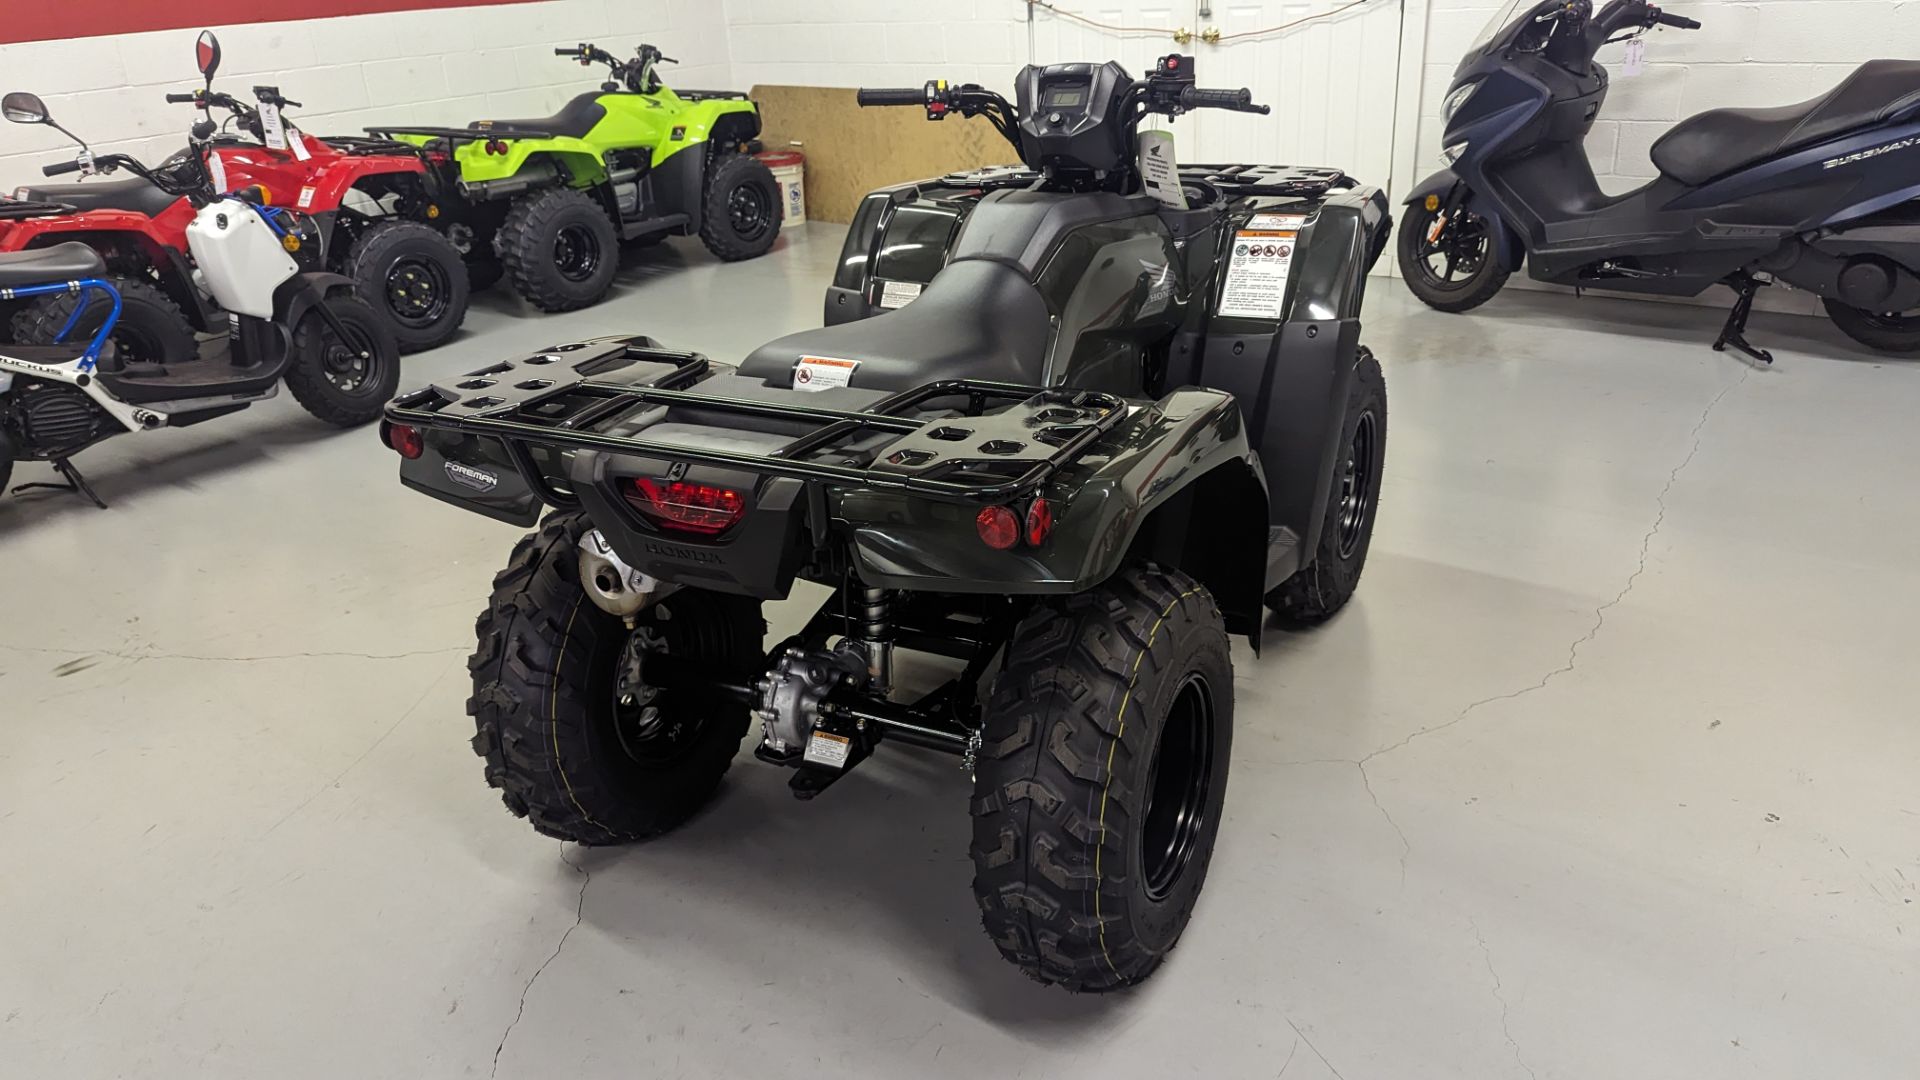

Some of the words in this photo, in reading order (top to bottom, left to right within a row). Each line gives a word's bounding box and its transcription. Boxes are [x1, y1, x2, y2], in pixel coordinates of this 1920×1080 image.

[1823, 138, 1914, 170] BURGMAN
[0, 357, 63, 376] UCKUS
[444, 461, 498, 486] FOREMAN
[645, 543, 726, 565] HONDA
